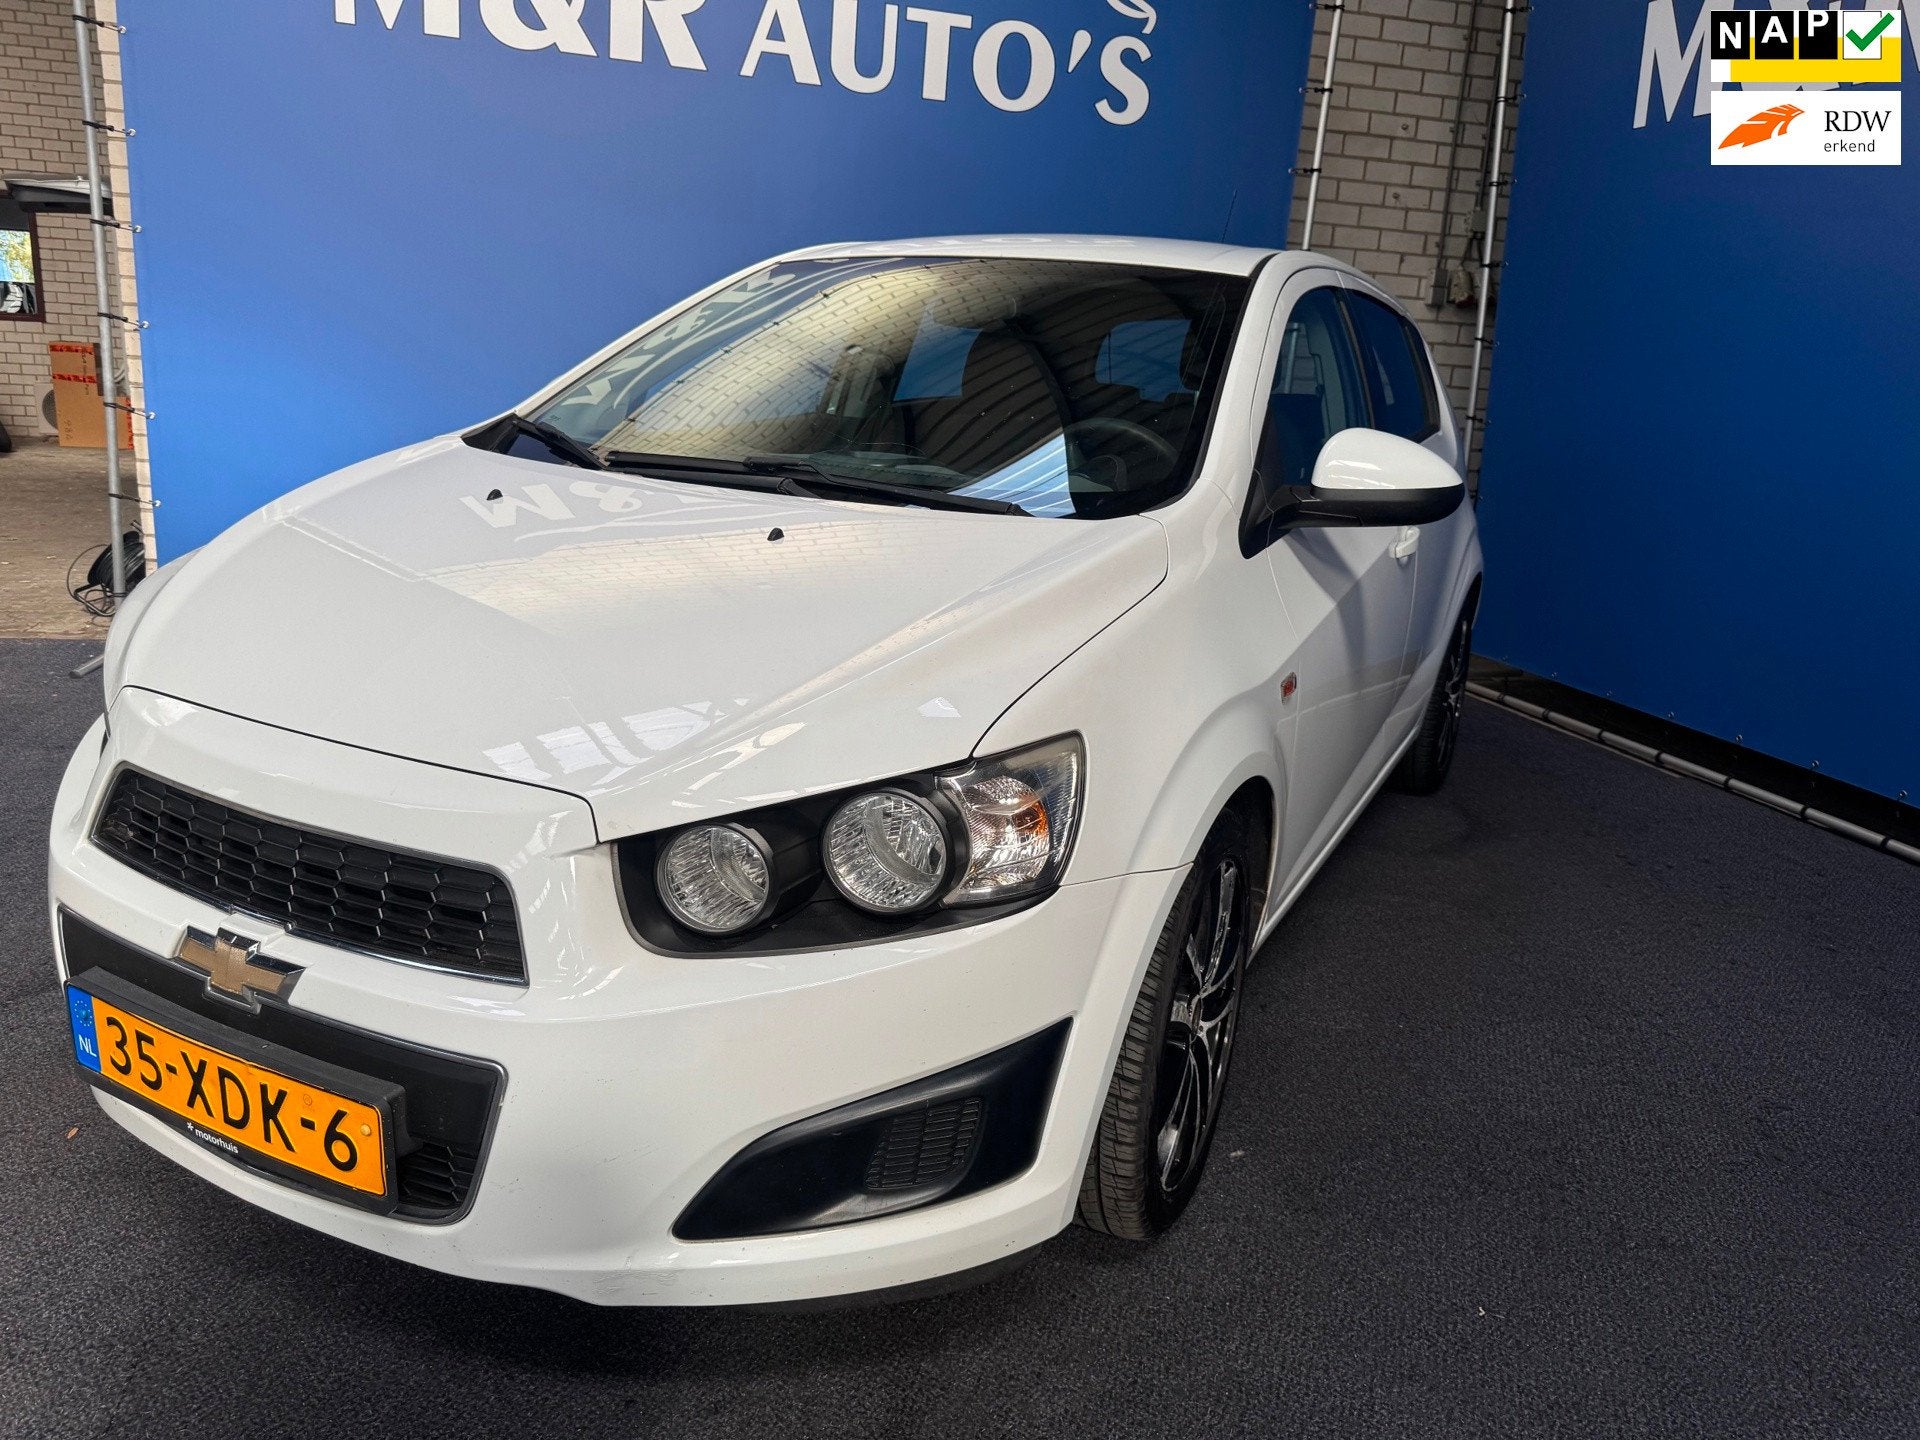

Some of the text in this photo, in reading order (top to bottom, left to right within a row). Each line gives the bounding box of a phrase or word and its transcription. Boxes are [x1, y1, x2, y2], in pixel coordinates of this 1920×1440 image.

[739, 0, 1154, 126] AUTO'S
[78, 1034, 97, 1057] NL
[106, 1016, 358, 1173] 35-XDK-6
[195, 1128, 239, 1154] motorhuis
